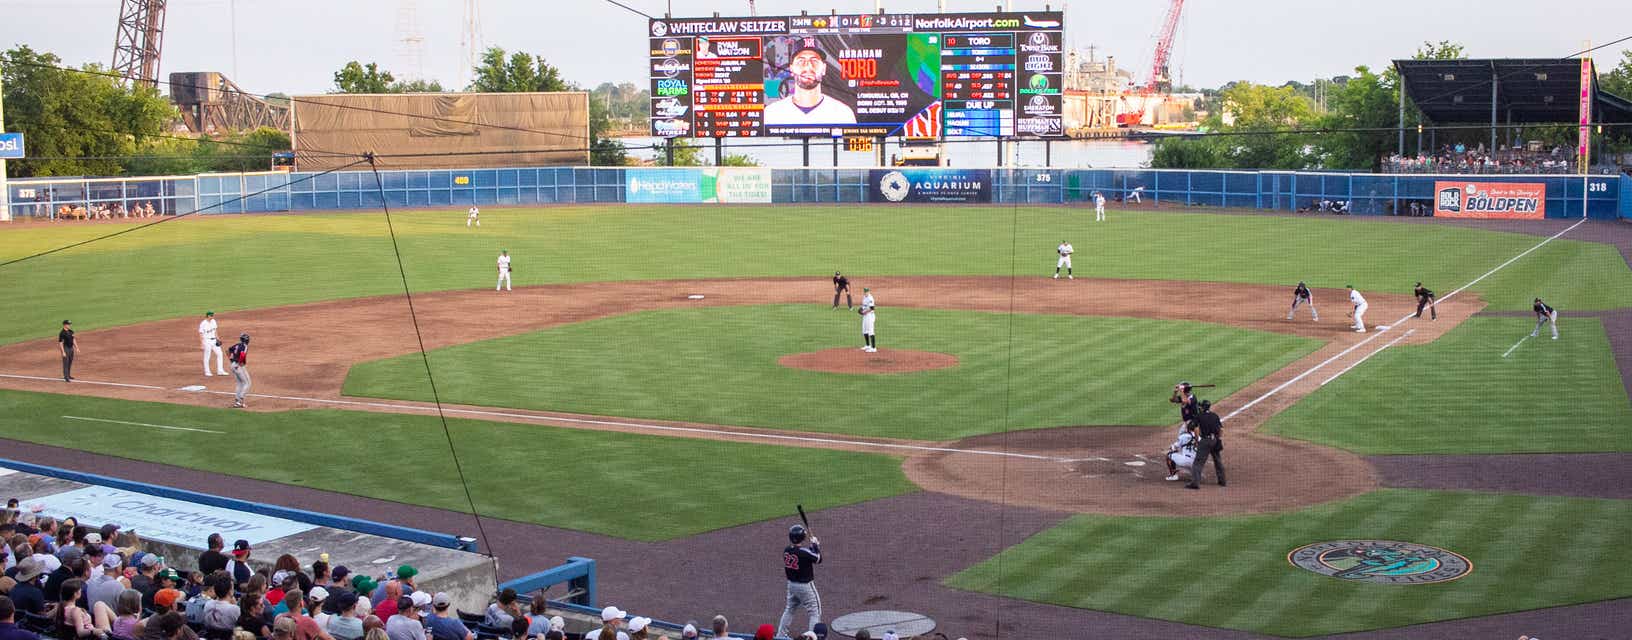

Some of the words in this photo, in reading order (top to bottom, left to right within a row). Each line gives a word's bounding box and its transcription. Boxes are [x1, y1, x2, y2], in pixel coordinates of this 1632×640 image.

[670, 22, 738, 34] WHITECLAW
[740, 20, 786, 32] SELTZER
[915, 18, 1019, 29] NorfolkAirport.com
[947, 38, 956, 46] 10
[968, 37, 990, 46] TORO
[839, 50, 882, 58] ABRAHAM
[838, 58, 877, 79] TORO
[657, 79, 687, 88] ROYAL
[658, 87, 688, 96] FARMS
[454, 176, 470, 185] 400
[1036, 174, 1050, 182] 375
[915, 182, 981, 190] AQUARIUM
[1589, 183, 1607, 192] 318
[19, 189, 36, 198] 375
[1441, 191, 1459, 199] BOLD
[1440, 198, 1459, 207] ROCK
[1466, 196, 1537, 212] BOLDPEN
[112, 500, 263, 532] Chartway
[784, 552, 800, 570] 22
